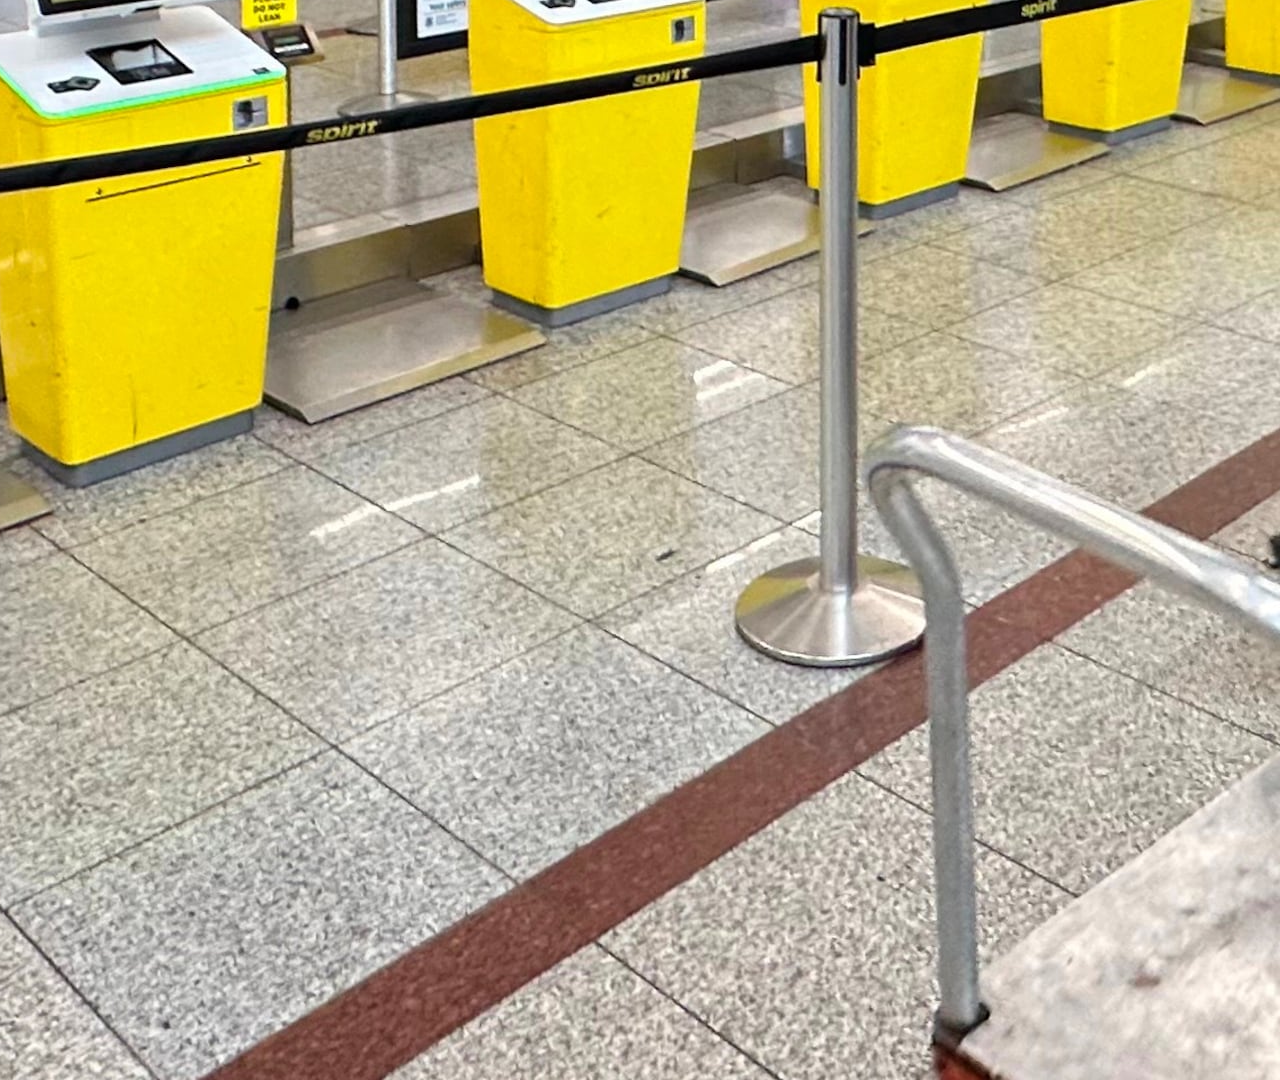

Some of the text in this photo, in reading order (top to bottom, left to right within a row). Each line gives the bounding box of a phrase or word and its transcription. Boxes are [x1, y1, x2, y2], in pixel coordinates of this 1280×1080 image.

[253, 2, 286, 14] DO NOT
[258, 13, 281, 23] LEAN
[632, 67, 692, 88] spirit
[306, 119, 378, 146] spirit
